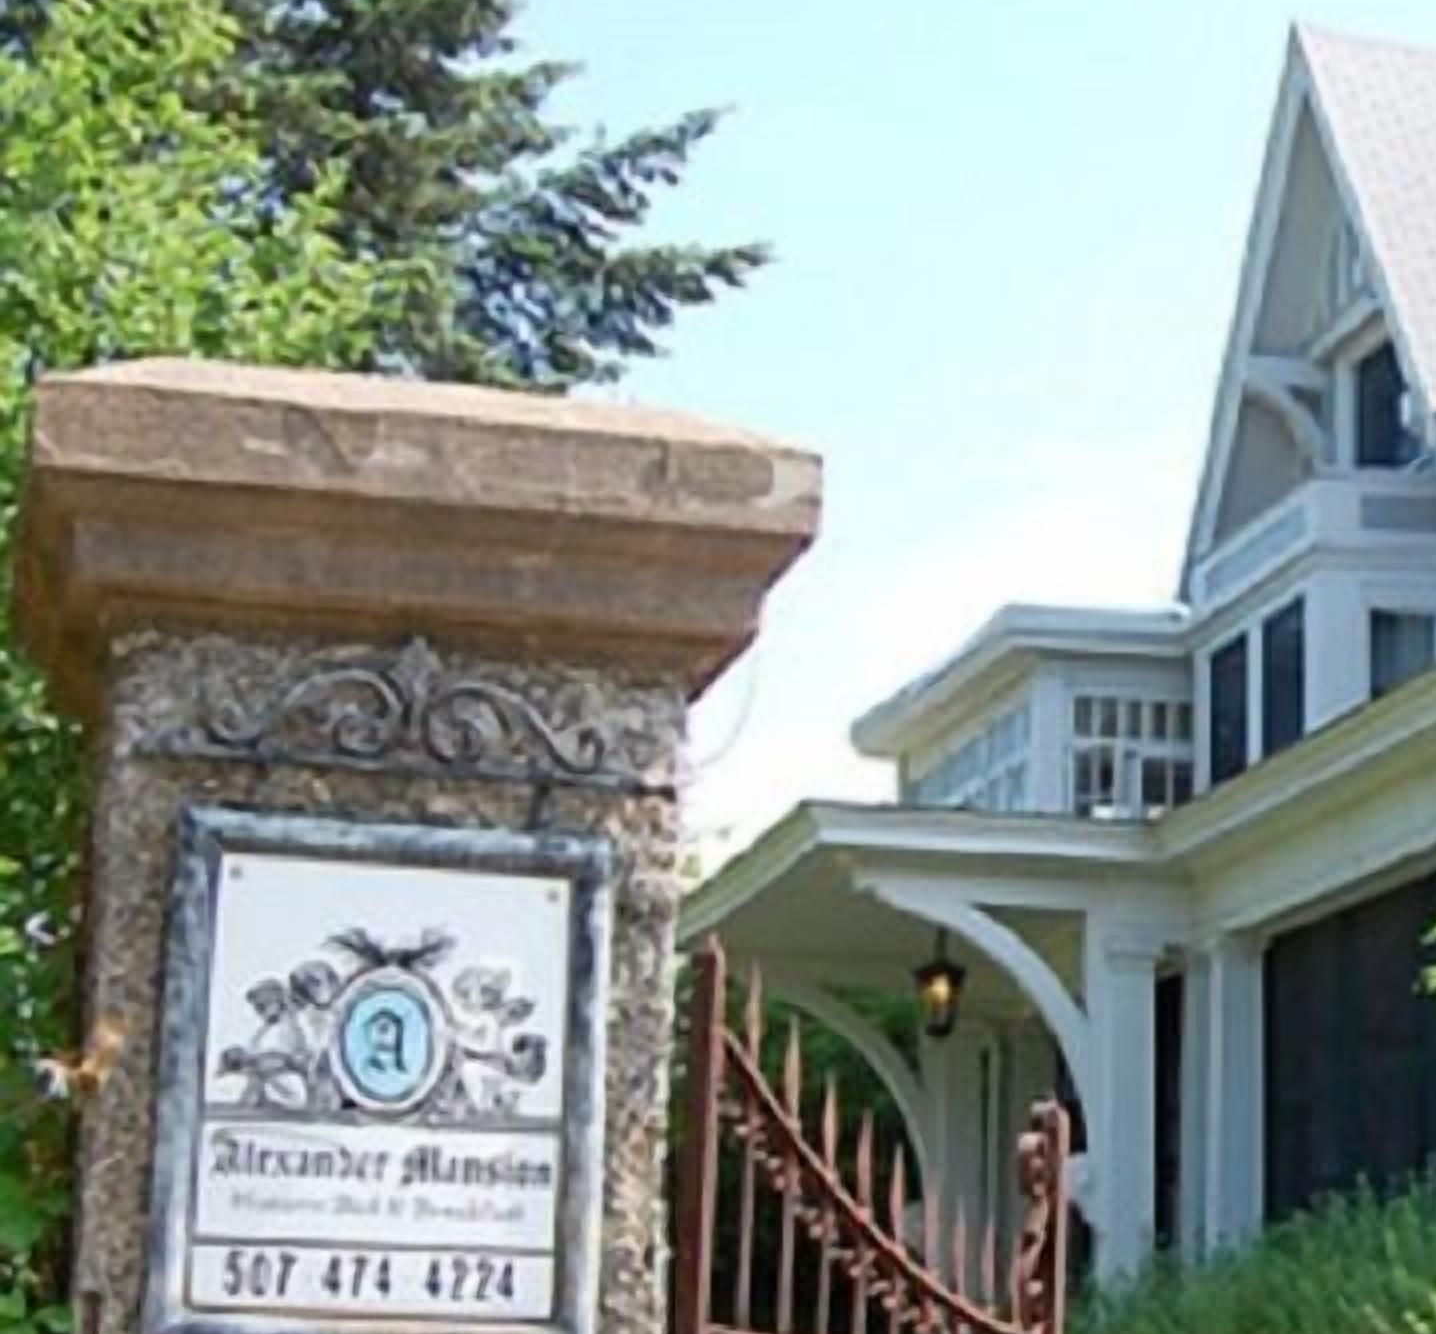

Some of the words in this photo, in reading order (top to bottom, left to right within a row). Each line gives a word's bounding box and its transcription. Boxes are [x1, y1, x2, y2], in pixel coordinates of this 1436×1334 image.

[210, 1129, 389, 1180] Alexander
[401, 1143, 552, 1189] Mansion
[224, 1249, 297, 1298] 507
[321, 1254, 391, 1299] 474
[423, 1257, 514, 1303] 4224
